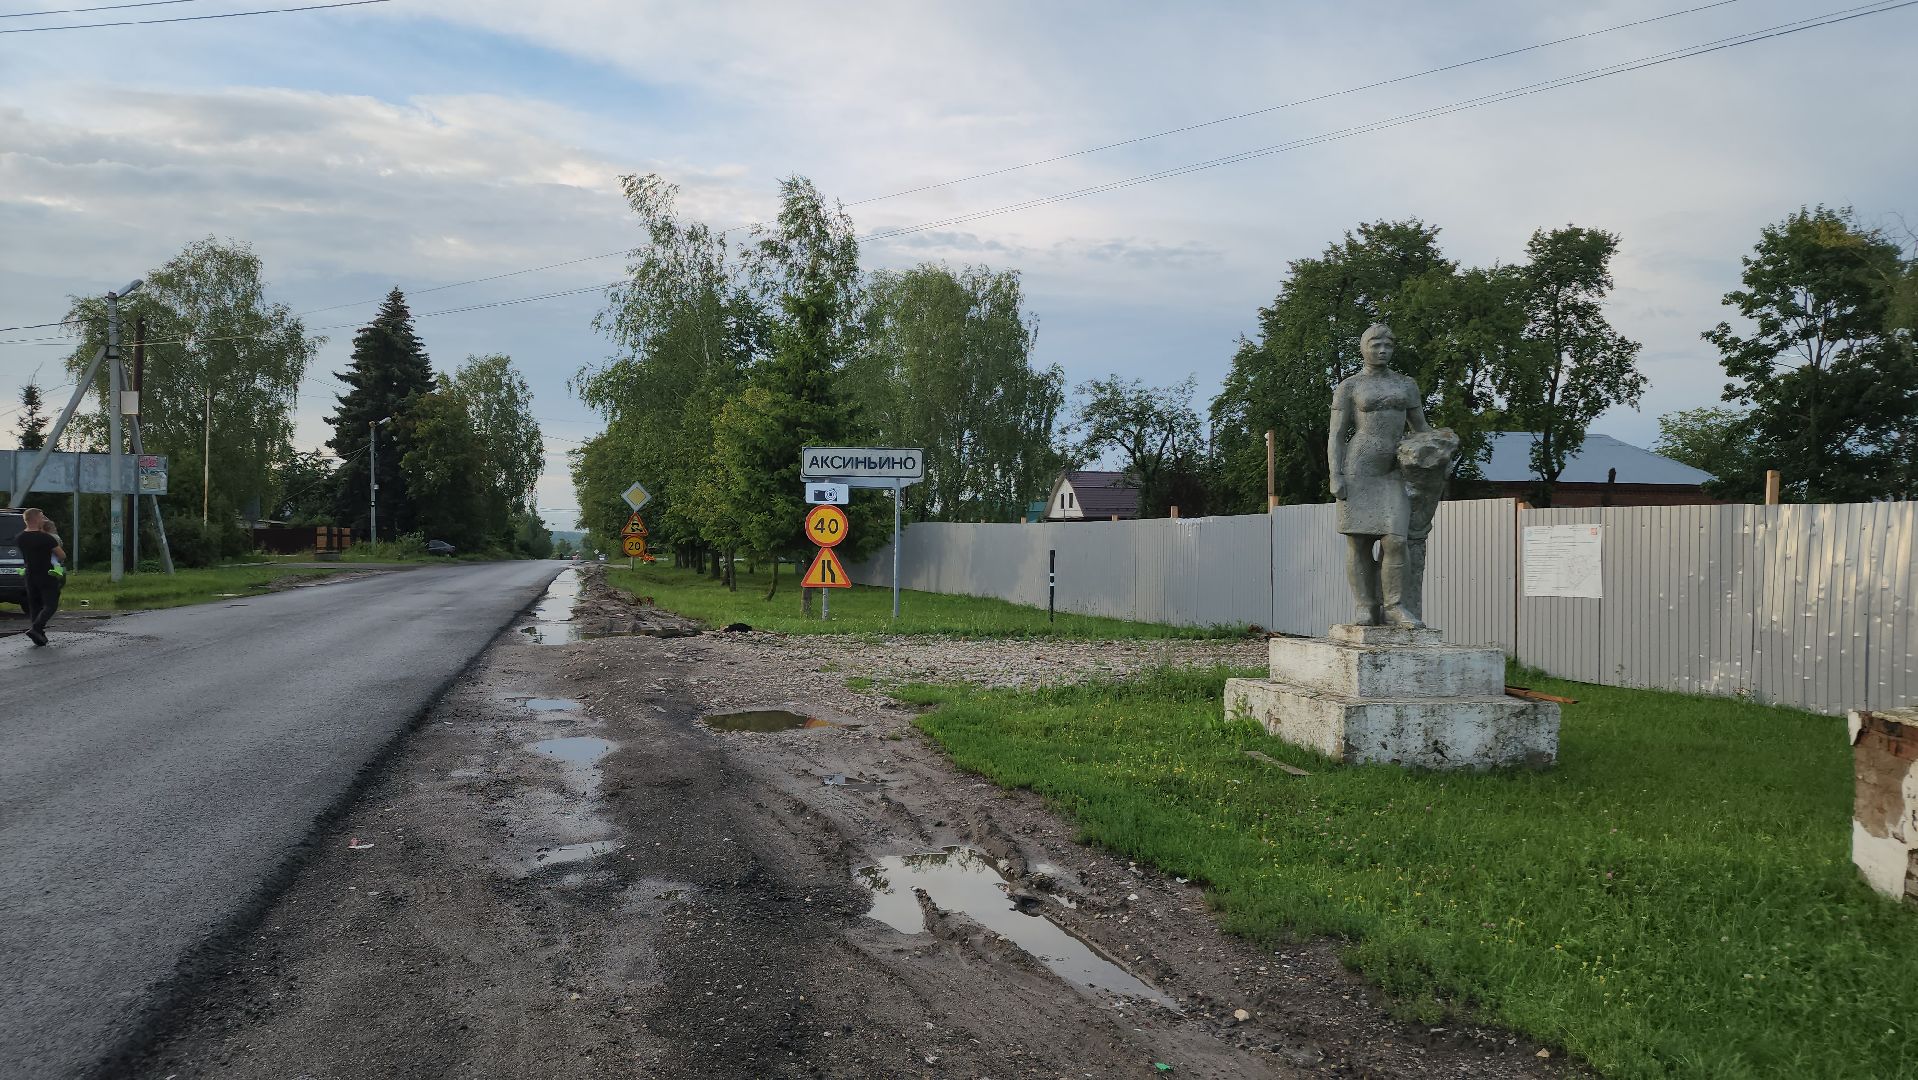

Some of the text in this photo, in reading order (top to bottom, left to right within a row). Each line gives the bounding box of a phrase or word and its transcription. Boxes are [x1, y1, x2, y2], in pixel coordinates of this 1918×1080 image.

[809, 455, 916, 470] АКСИНЬИНО
[814, 518, 839, 534] 40
[628, 541, 641, 551] 20
